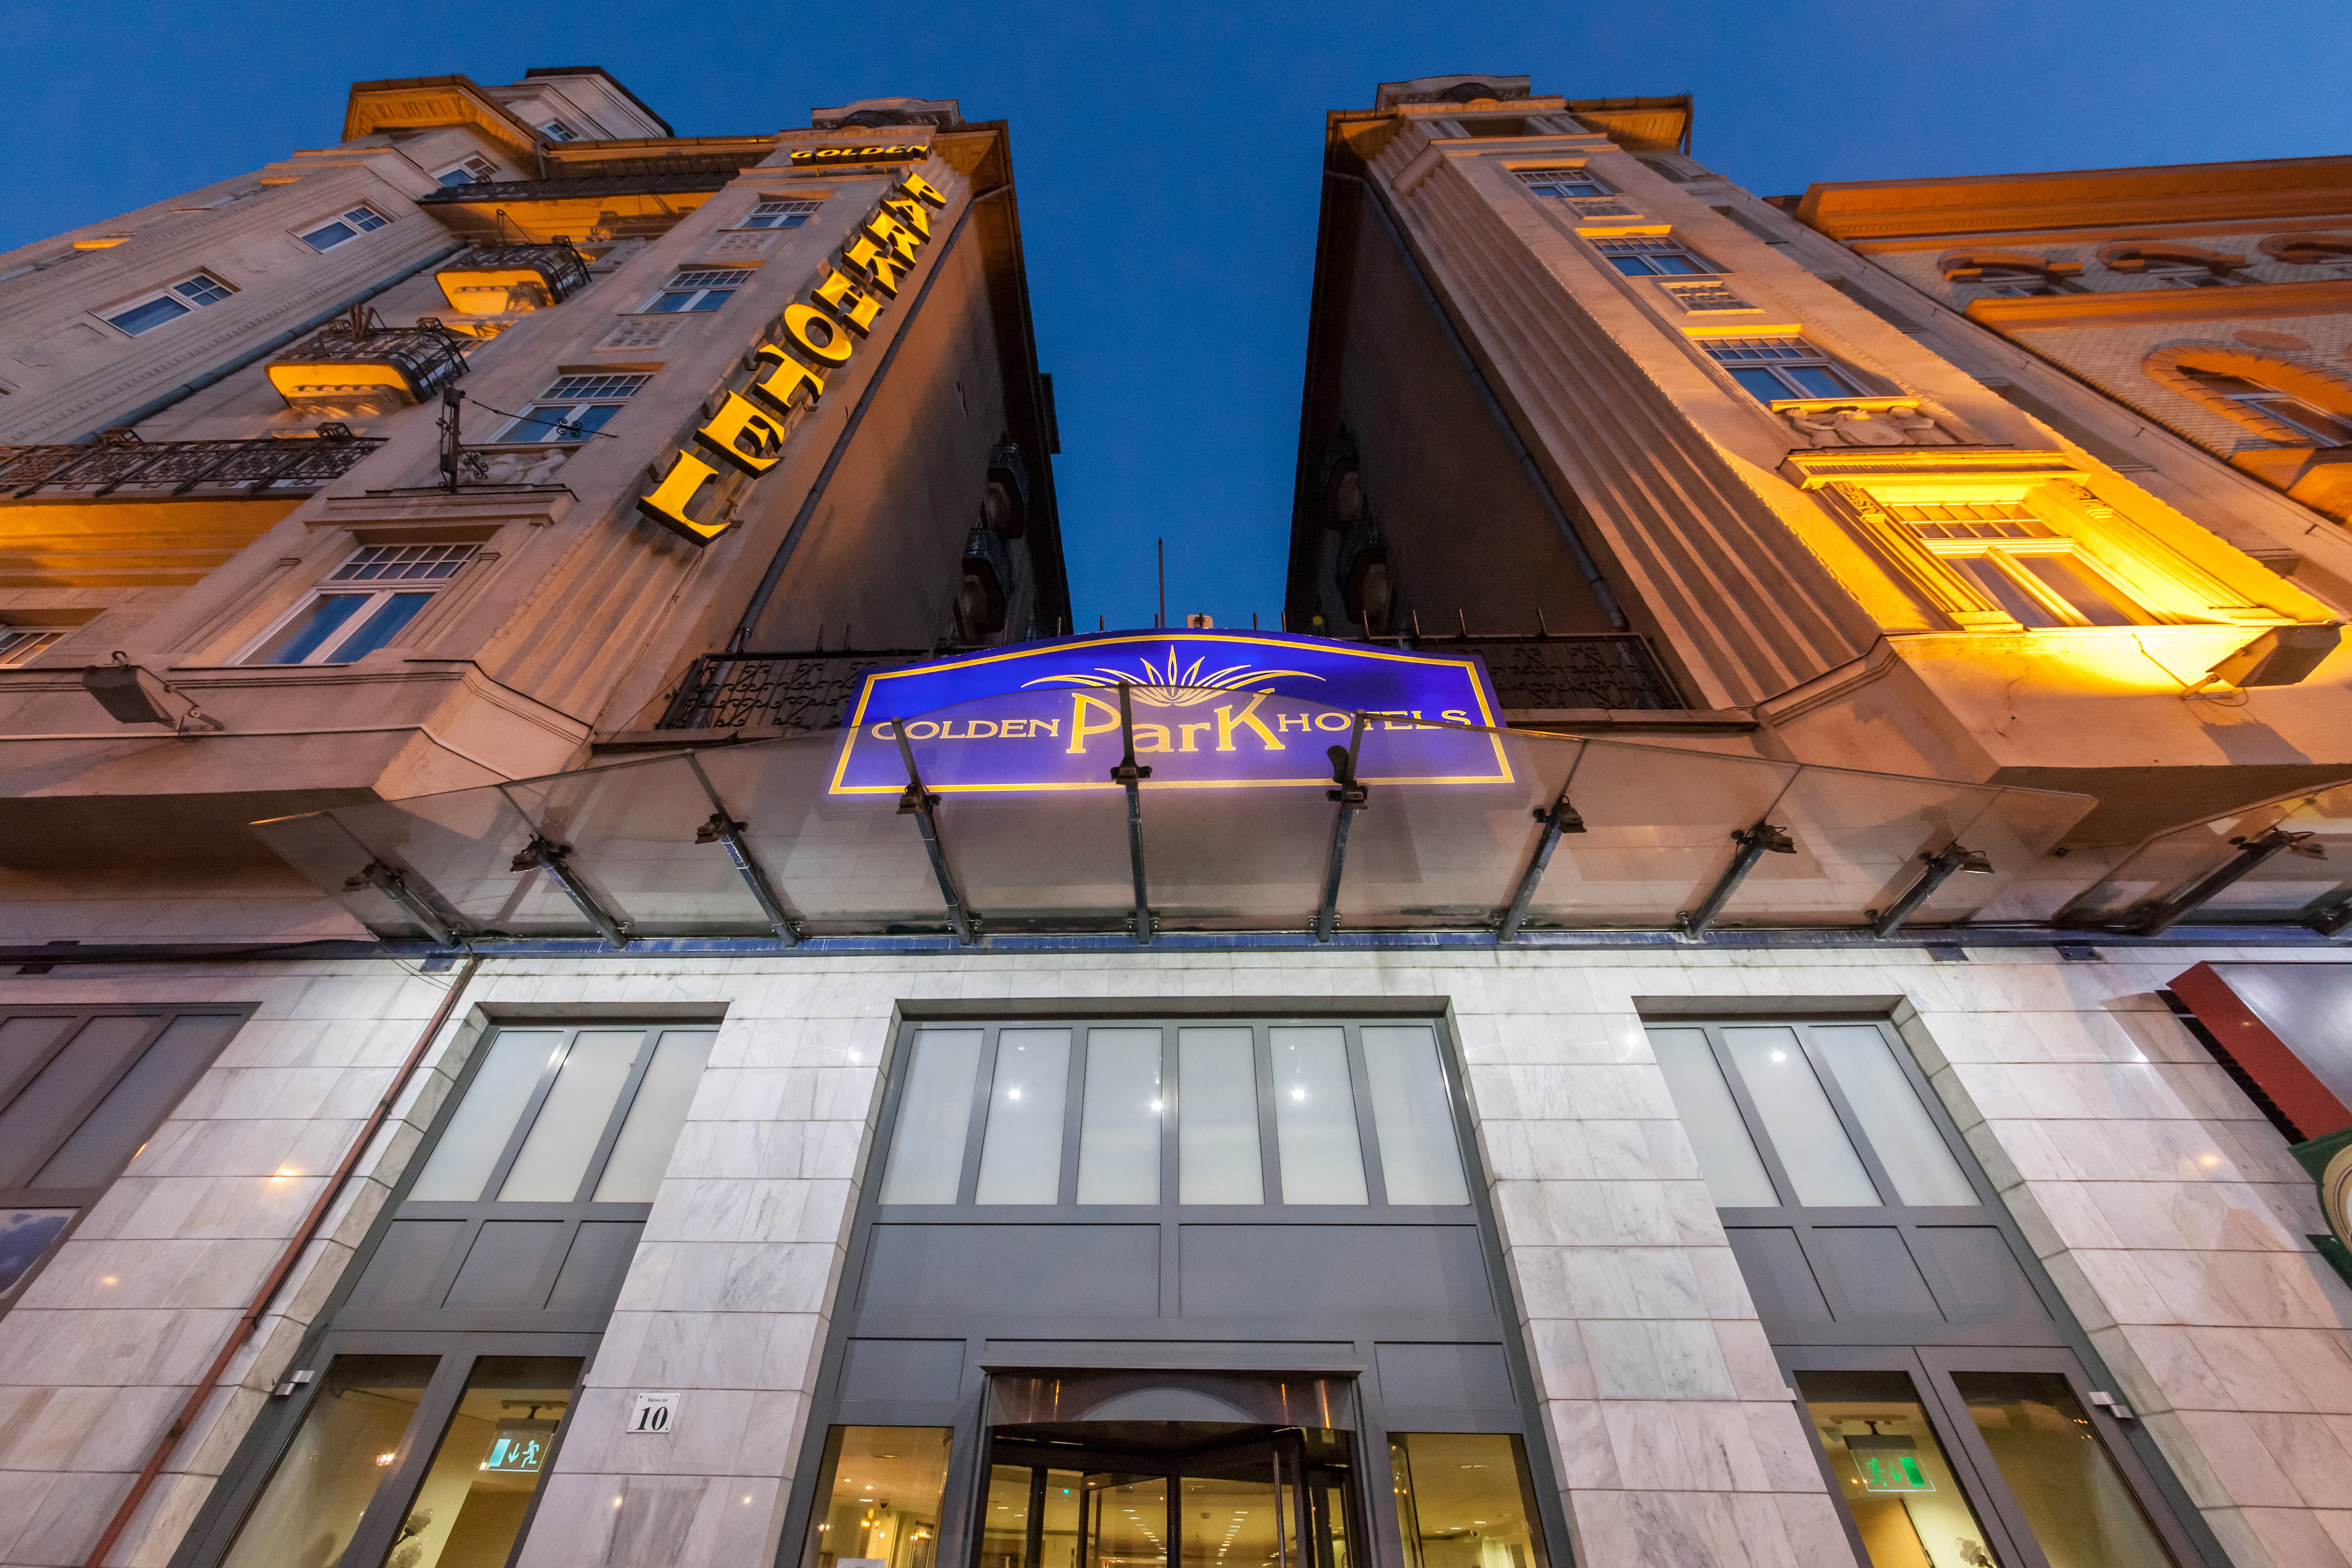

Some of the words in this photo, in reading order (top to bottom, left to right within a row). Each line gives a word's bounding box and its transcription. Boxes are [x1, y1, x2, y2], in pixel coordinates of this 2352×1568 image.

[790, 145, 928, 159] GOLDEN
[844, 172, 947, 297] PARK
[640, 267, 884, 542] HOTEL
[871, 719, 1060, 740] GOLDEN
[635, 1406, 668, 1431] 10
